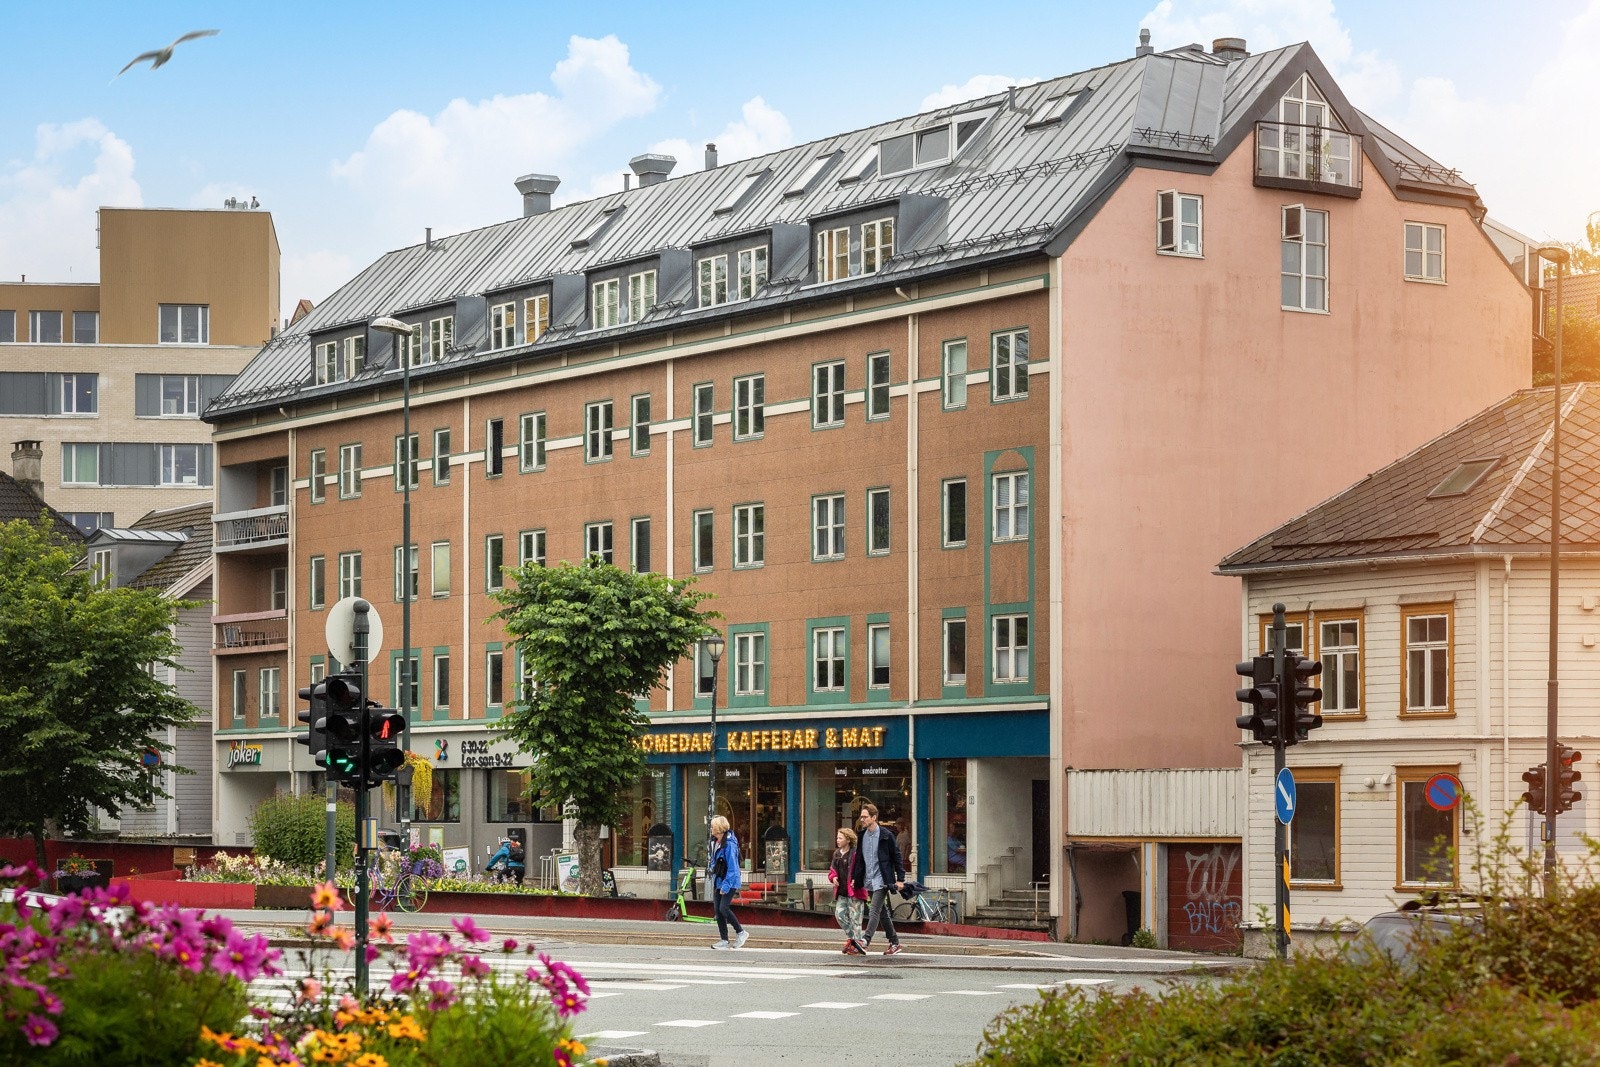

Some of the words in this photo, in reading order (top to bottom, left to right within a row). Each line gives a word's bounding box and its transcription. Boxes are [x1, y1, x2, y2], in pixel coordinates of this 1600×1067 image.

[727, 728, 819, 751] KAFFEBAR
[825, 727, 841, 749] &
[842, 726, 886, 748] MAT
[227, 740, 257, 768] joker
[725, 769, 740, 777] bowls
[834, 766, 848, 777] lunsj
